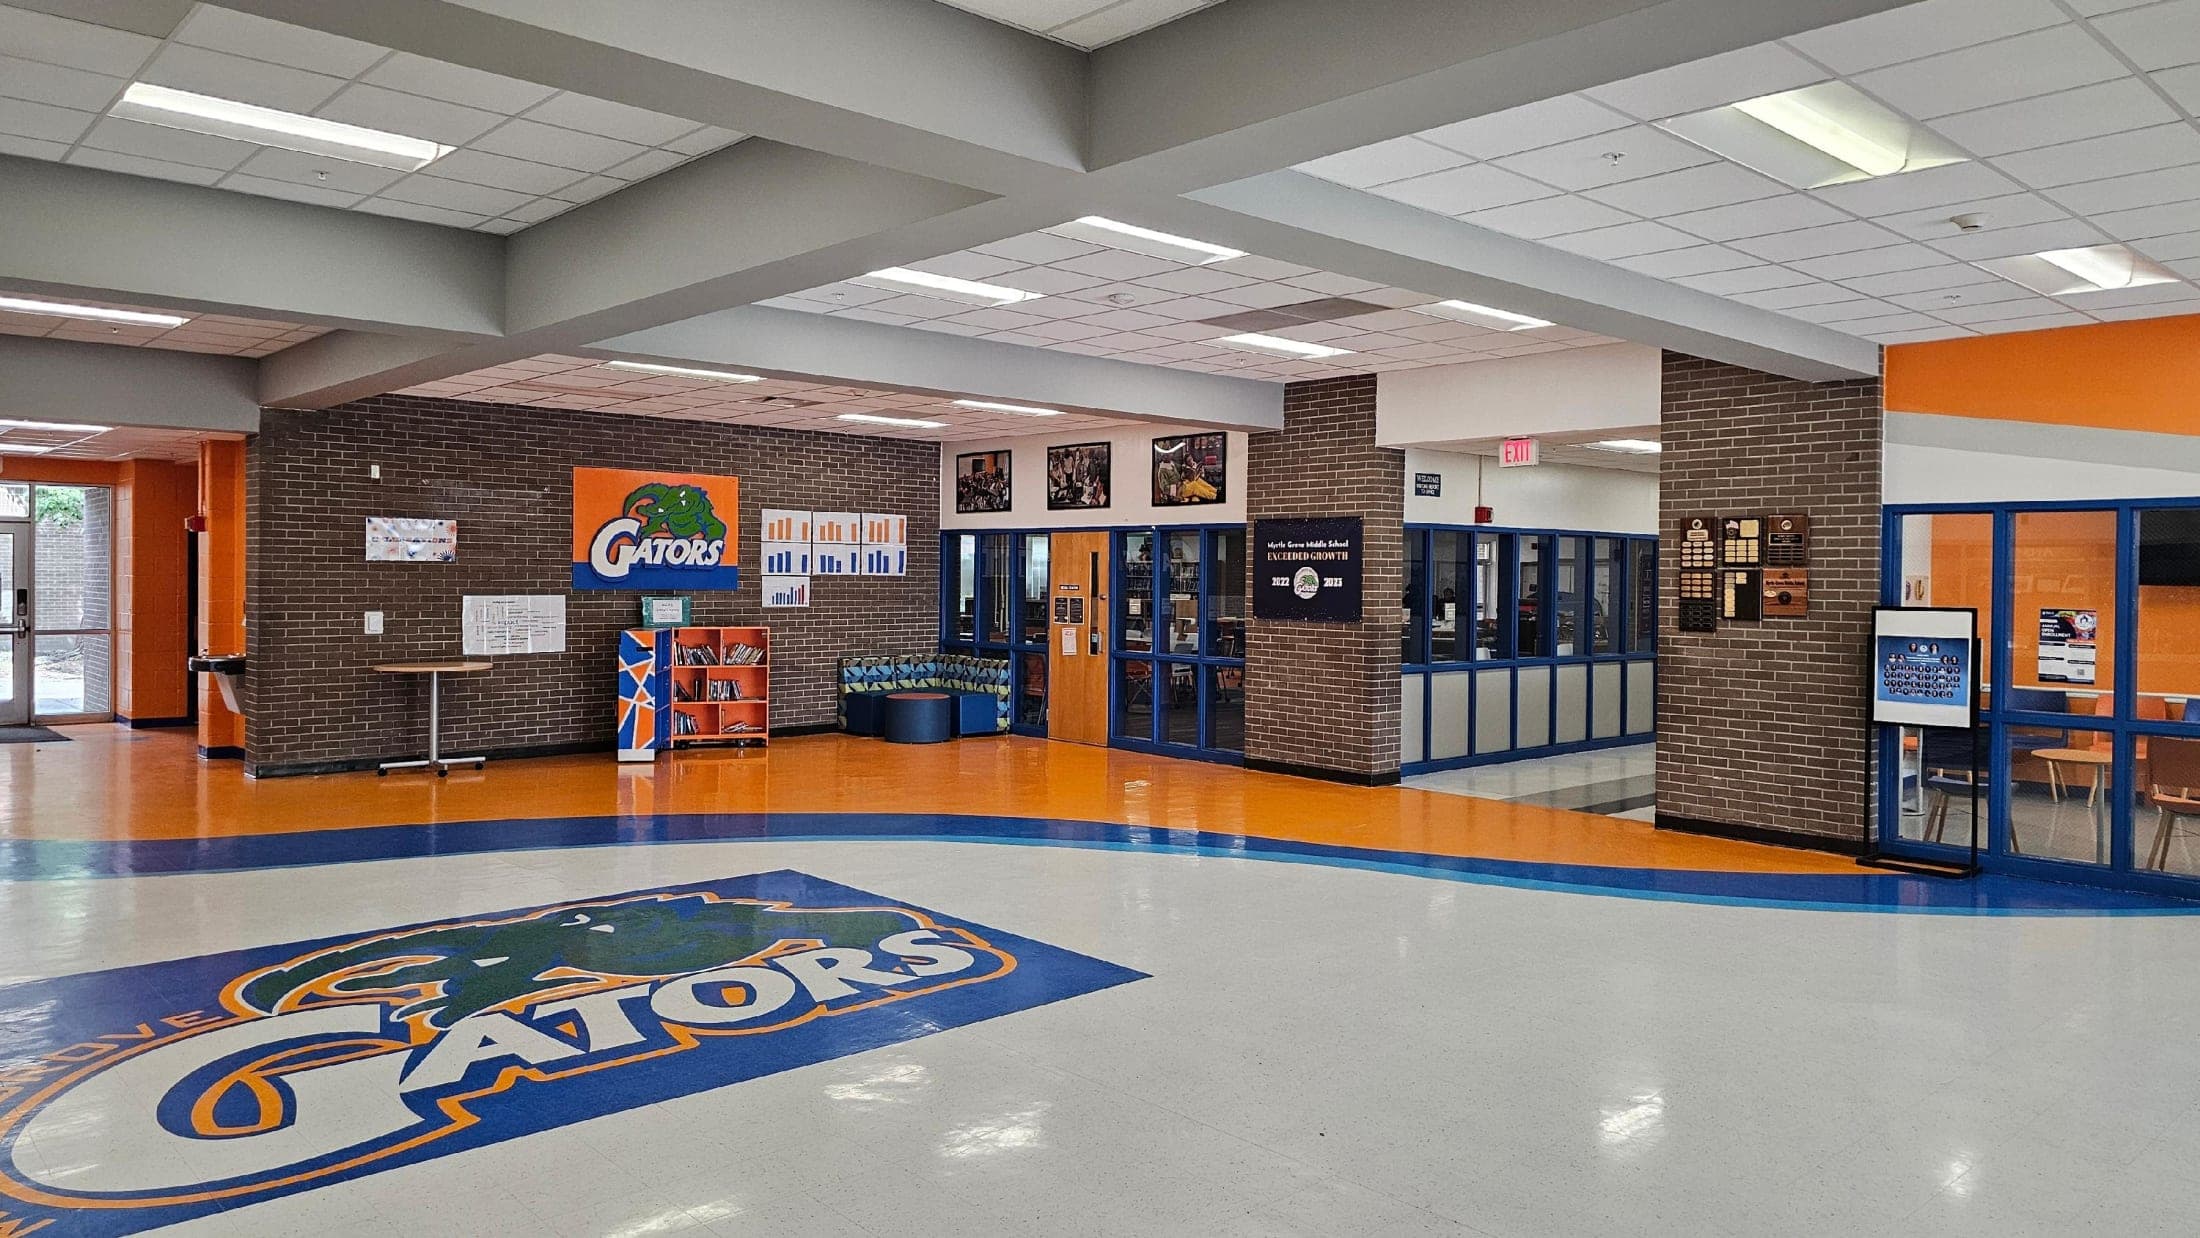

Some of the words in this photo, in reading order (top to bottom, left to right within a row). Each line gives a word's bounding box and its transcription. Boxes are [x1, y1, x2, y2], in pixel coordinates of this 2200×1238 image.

[1504, 441, 1531, 464] EXIT
[591, 518, 723, 578] GATORS
[1267, 540, 1286, 550] Myrtle
[1287, 540, 1305, 548] Grove
[1306, 540, 1327, 548] Middle
[1328, 539, 1349, 548] School
[1267, 551, 1309, 560] EXCEEDED
[1310, 551, 1349, 560] GROWTH
[1271, 577, 1290, 587] 2022
[1323, 577, 1343, 588] 2023
[11, 930, 976, 1192] GATORS
